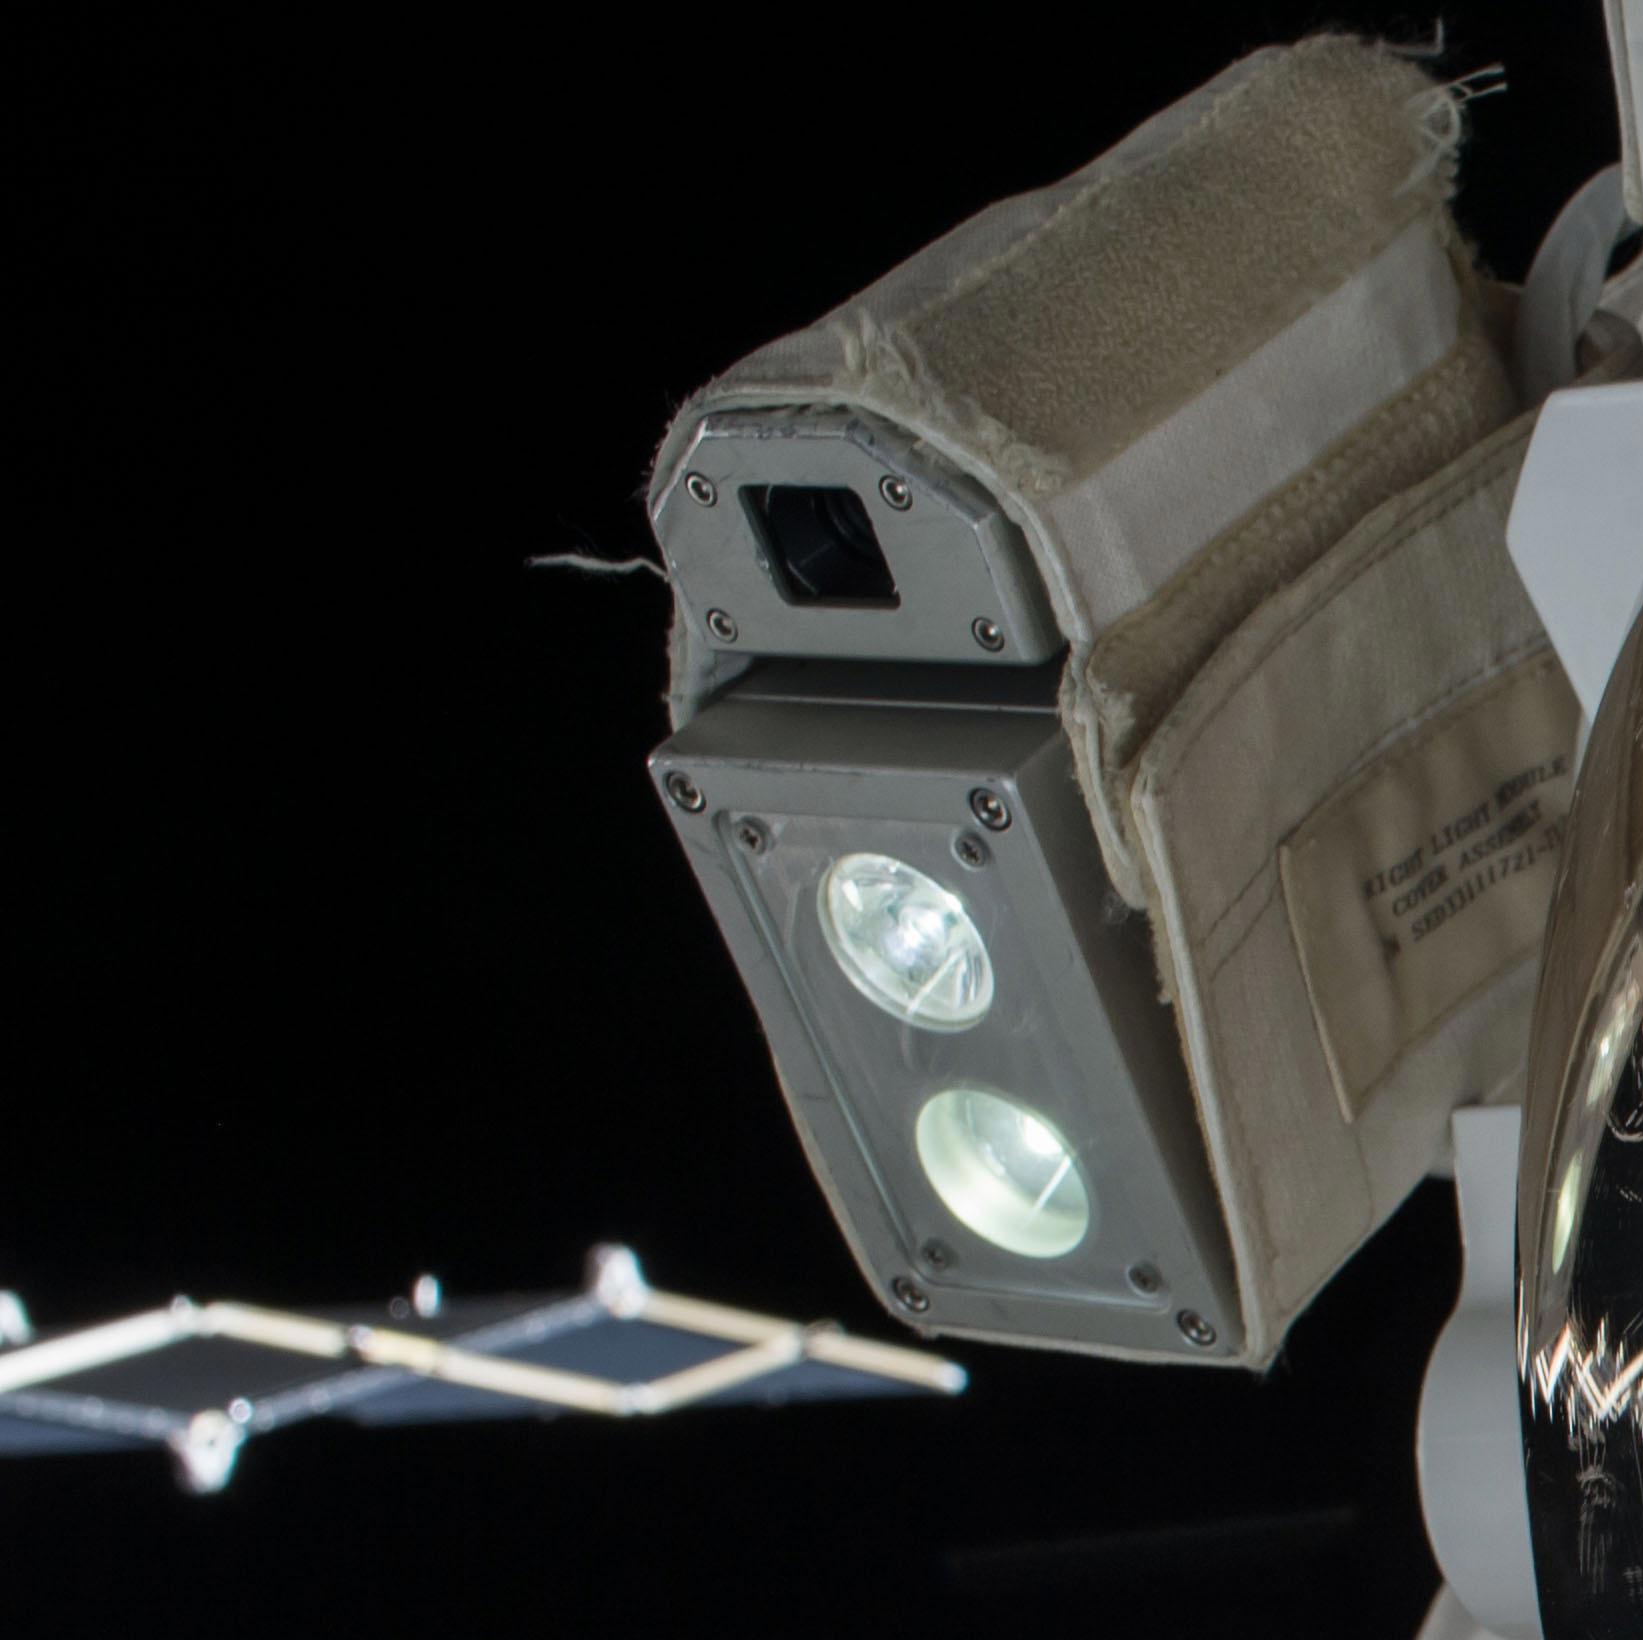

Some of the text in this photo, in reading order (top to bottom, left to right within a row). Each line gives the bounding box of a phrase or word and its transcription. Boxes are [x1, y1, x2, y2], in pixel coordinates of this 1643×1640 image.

[1361, 848, 1424, 901] RIGHT
[1431, 802, 1490, 855] LIGHT
[1392, 864, 1448, 917] COVER
